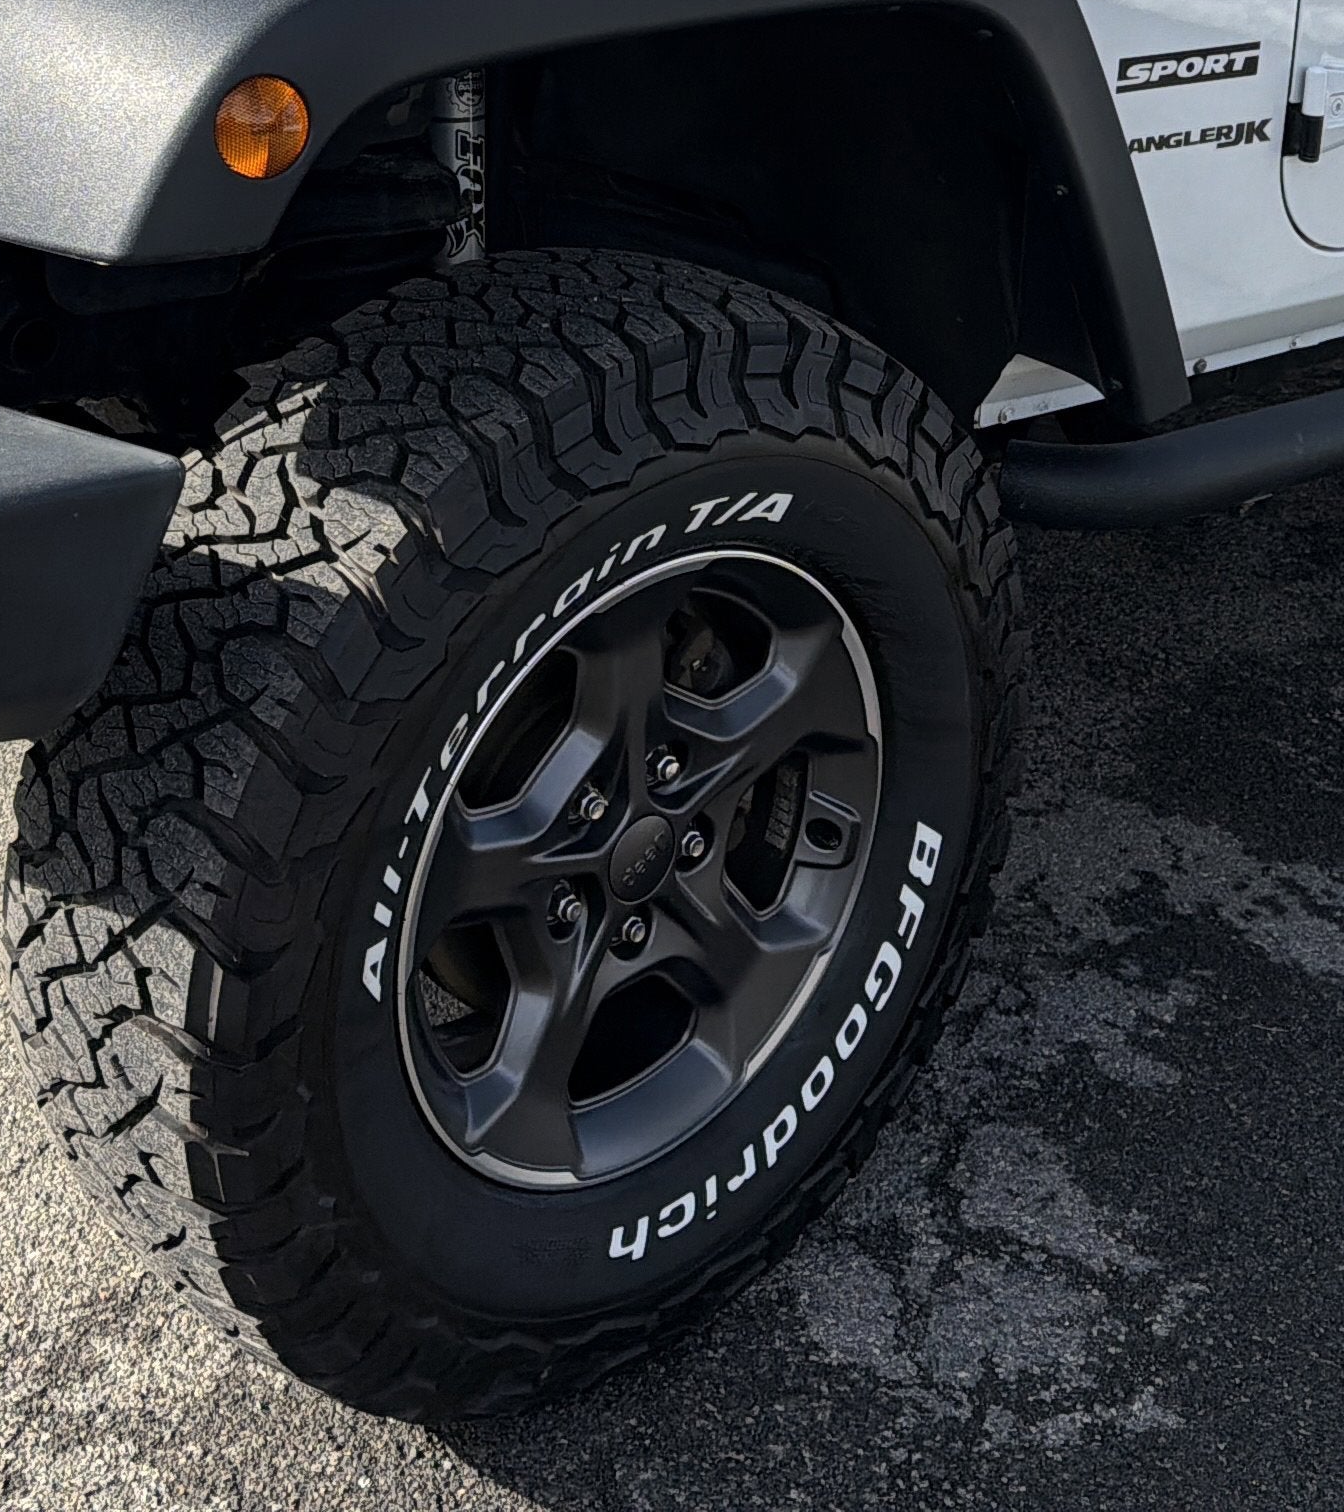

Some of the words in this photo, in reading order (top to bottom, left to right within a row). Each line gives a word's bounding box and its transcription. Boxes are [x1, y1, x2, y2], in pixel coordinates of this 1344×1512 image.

[1117, 49, 1260, 86] SPORT
[361, 522, 668, 1004] All-Terrain
[683, 491, 795, 534] T/A
[607, 821, 944, 1262] BFGoodrich
